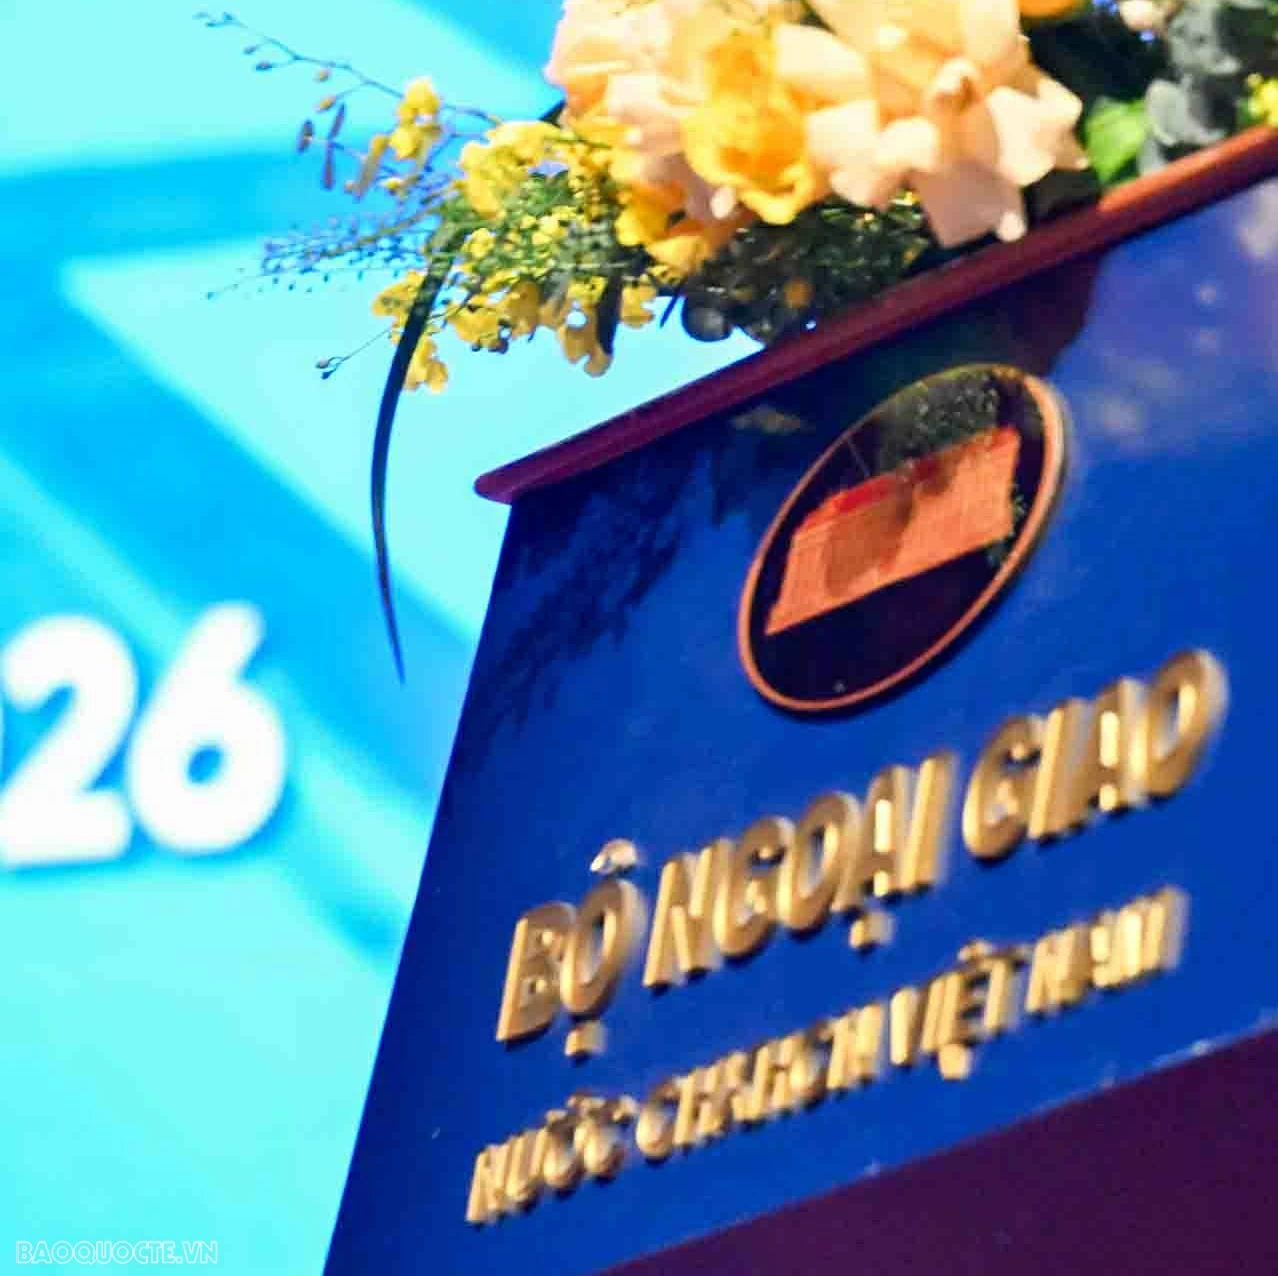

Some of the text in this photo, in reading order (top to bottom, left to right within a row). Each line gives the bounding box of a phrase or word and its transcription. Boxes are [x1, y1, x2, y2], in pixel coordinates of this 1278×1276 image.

[0, 600, 287, 867] 26
[496, 649, 1230, 1057] BỘ NGOẠI GIAO
[889, 936, 1034, 1081] VIỆT
